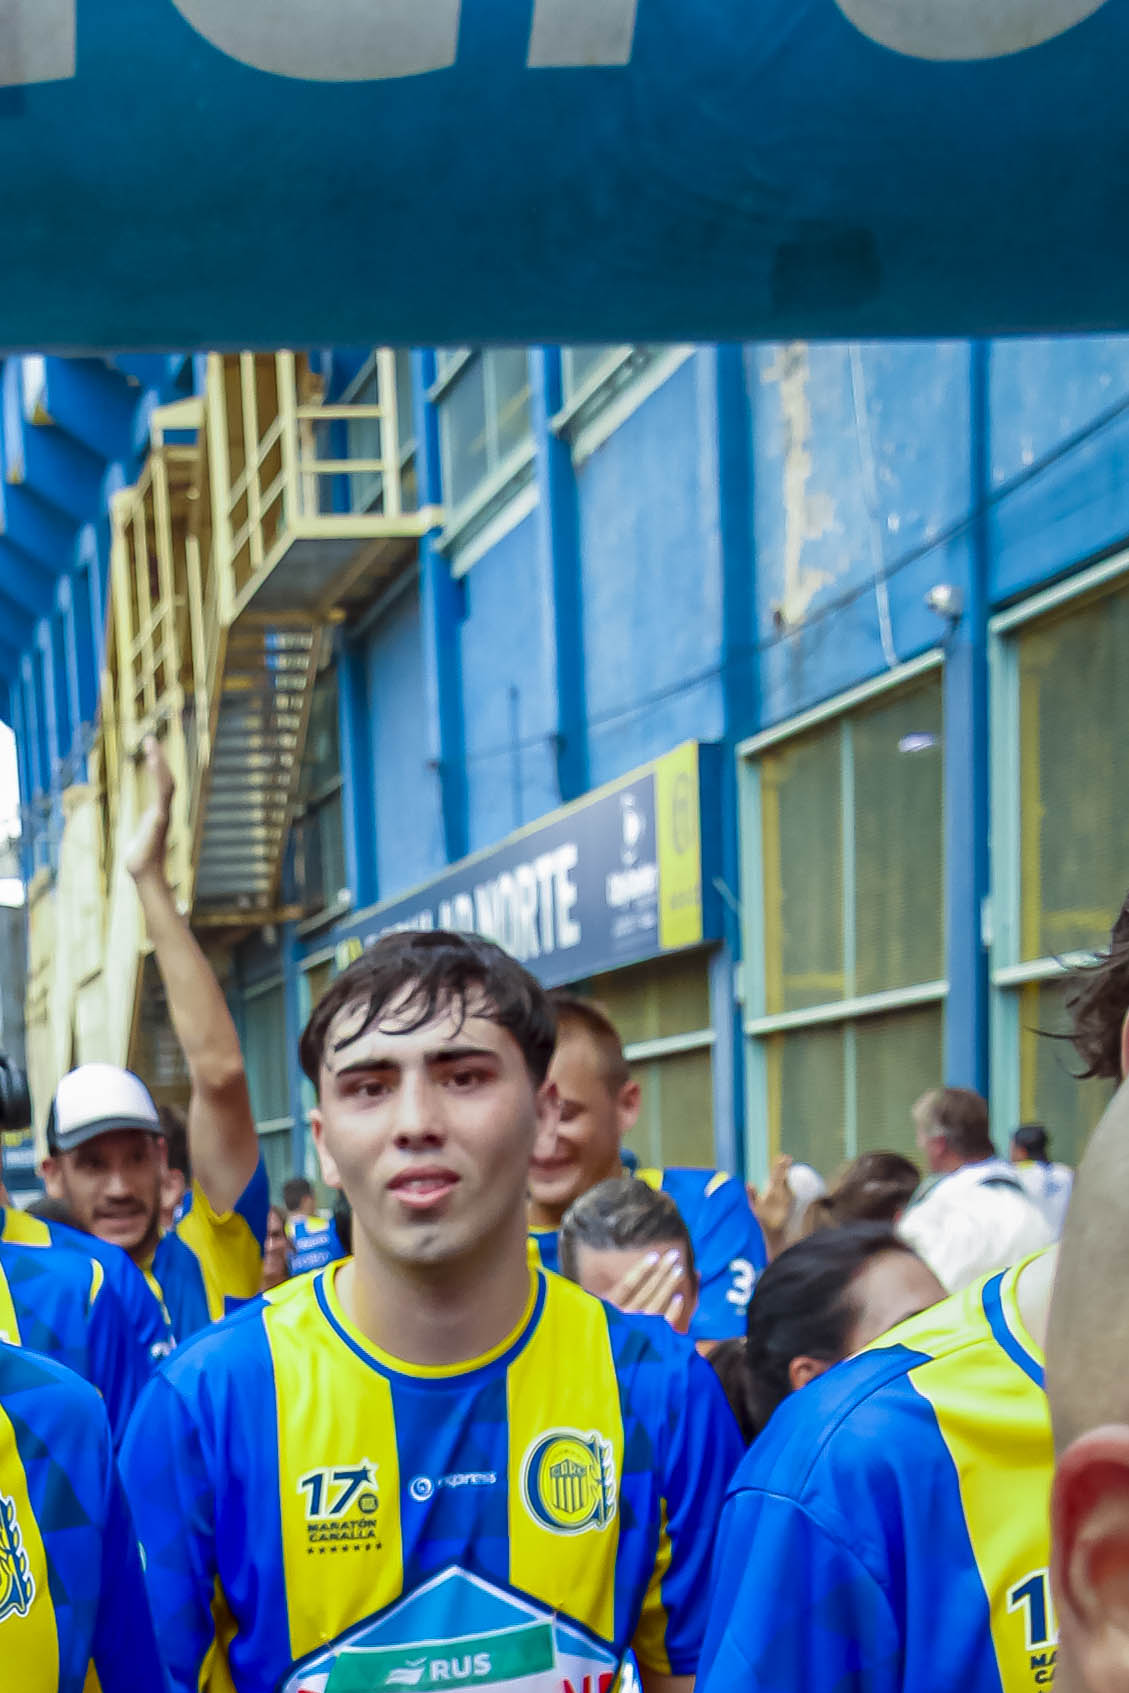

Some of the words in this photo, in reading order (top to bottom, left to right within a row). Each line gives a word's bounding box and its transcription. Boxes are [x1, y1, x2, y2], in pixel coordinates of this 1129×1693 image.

[298, 1459, 378, 1519] 17
[1007, 1567, 1059, 1651] 1
[430, 1653, 492, 1681] RUS
